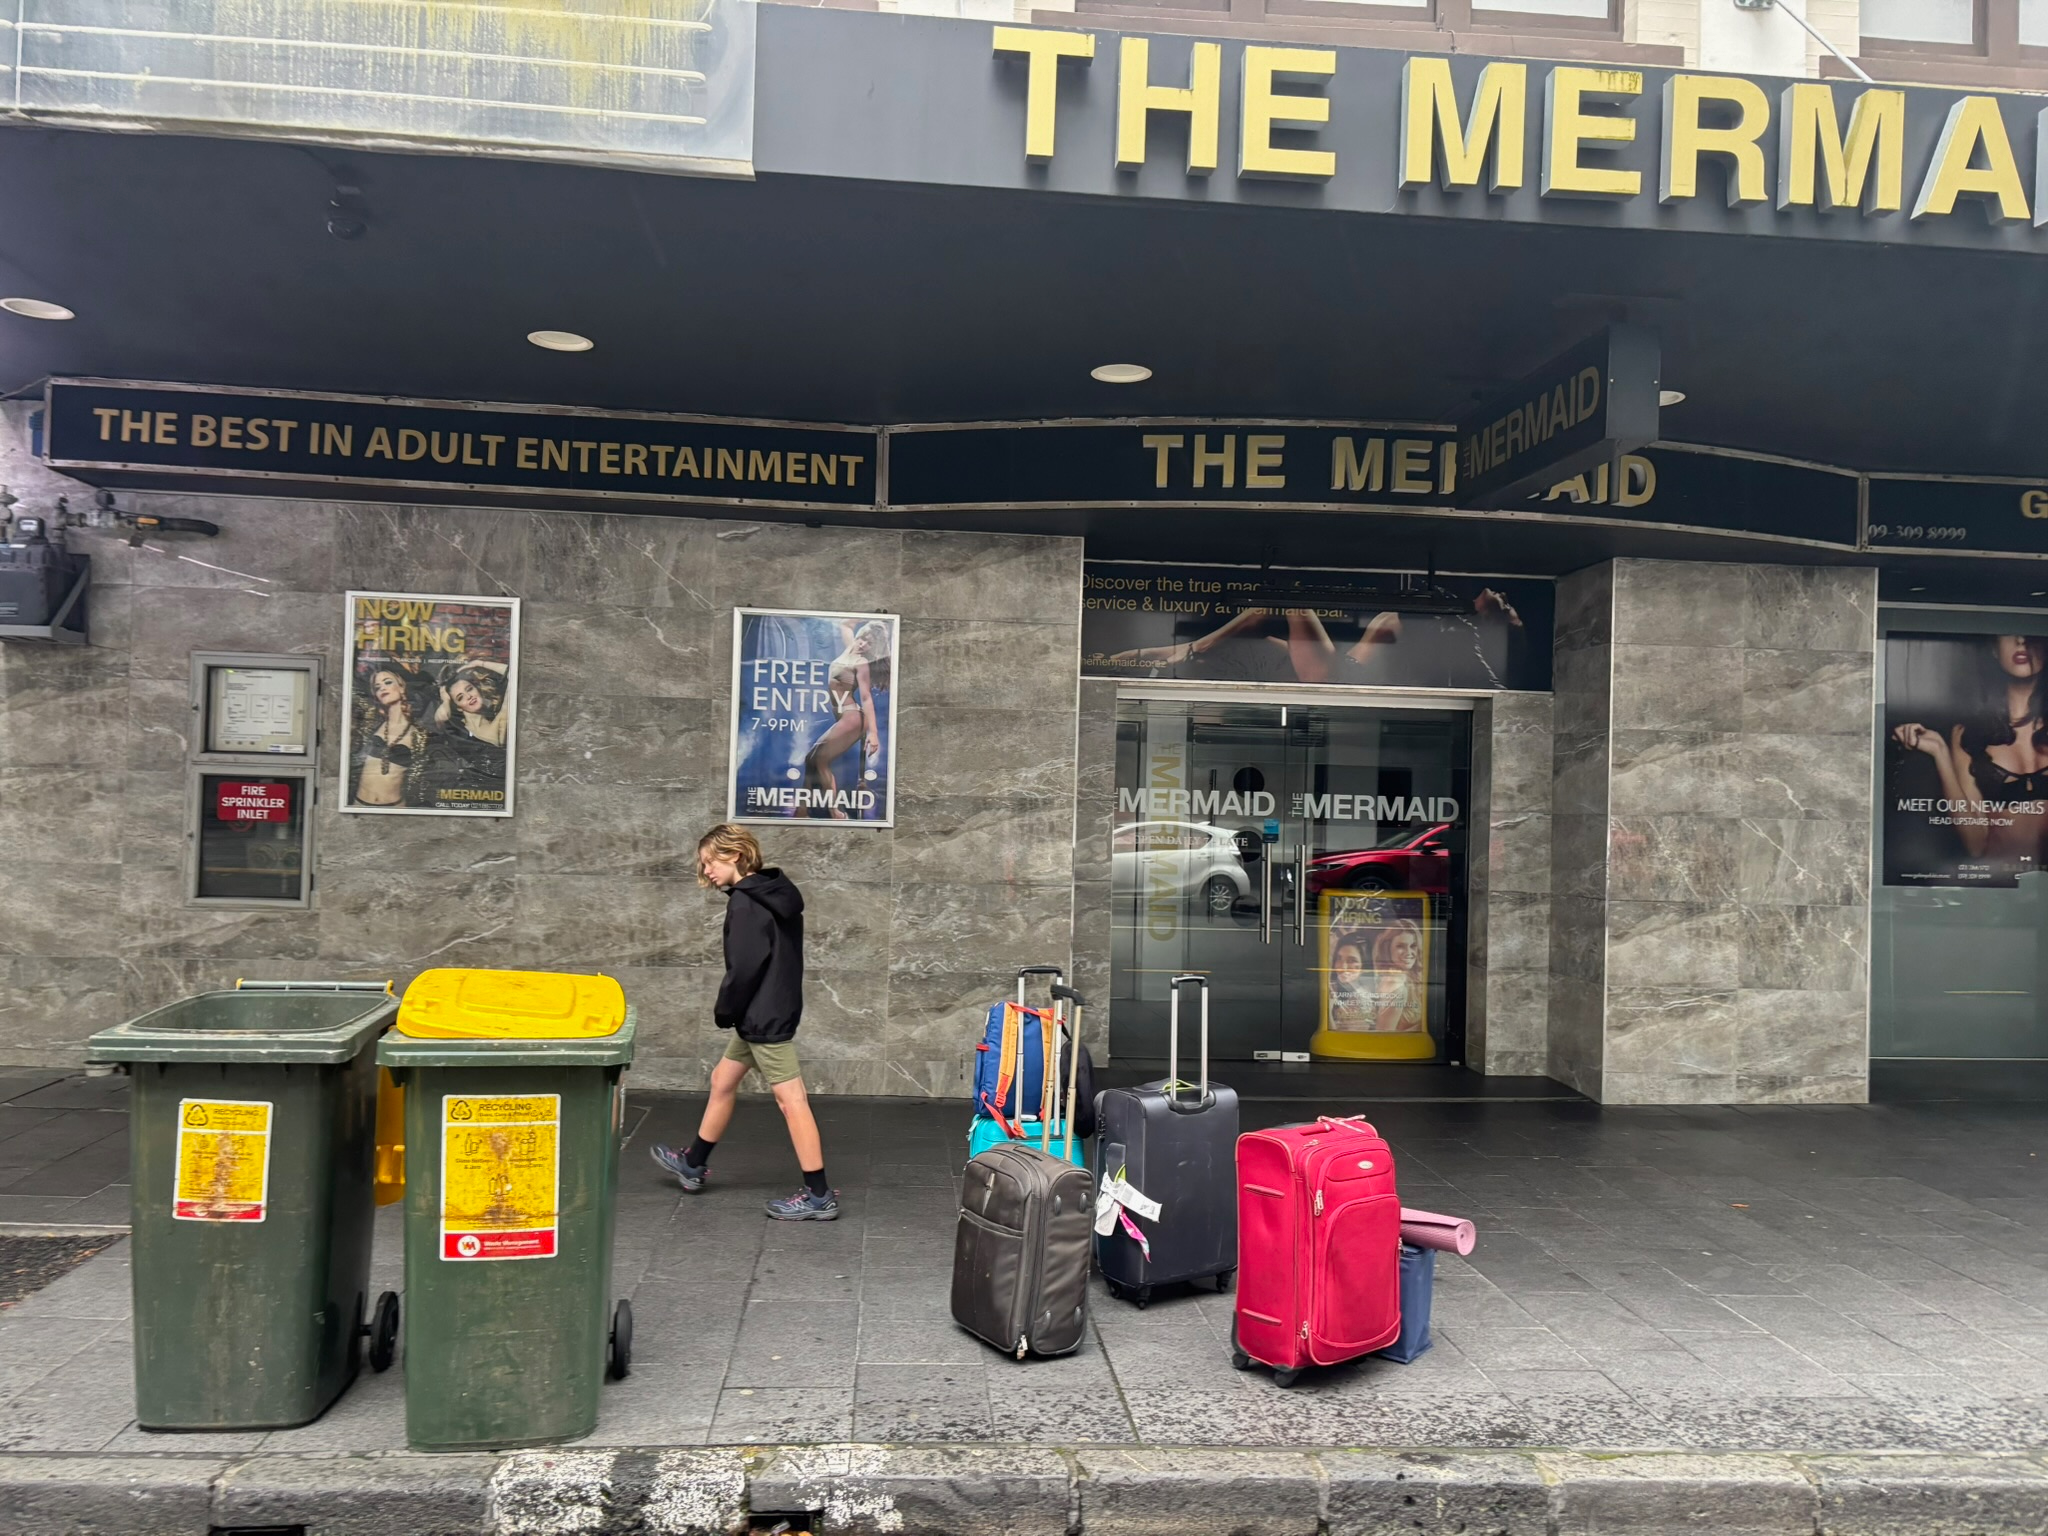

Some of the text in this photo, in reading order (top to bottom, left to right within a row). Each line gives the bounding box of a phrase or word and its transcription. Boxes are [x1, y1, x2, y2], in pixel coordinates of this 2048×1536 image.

[991, 26, 2048, 226] THE MERMA
[1469, 366, 1600, 480] MERMAID
[93, 408, 864, 488] THE BEST IN ADULT ENTERTAINMENT
[1142, 434, 1287, 491] THE
[1083, 575, 1153, 591] Discover
[1156, 577, 1184, 592] the
[1188, 578, 1222, 593] true
[357, 598, 435, 621] NOW
[1081, 595, 1137, 611] service
[1141, 595, 1155, 612] &
[1159, 597, 1212, 616] luxury
[357, 624, 466, 653] HIRING
[753, 659, 825, 686] FREE
[752, 686, 850, 714] ENTRY
[221, 796, 285, 809] SPRINKLER
[241, 785, 267, 797] FIRE
[440, 789, 504, 801] MERMAID
[747, 786, 875, 810] THE MERMAID
[1118, 787, 1276, 817] MERMAID
[236, 808, 270, 820] INLET
[1291, 792, 1460, 823] THE MERMAID
[1897, 798, 2045, 815] MEET OUR NEW GIRLS
[1928, 816, 1952, 826] HEAD
[1953, 817, 1990, 827] UPSTAIRS
[1219, 837, 1249, 847] LATE
[479, 1103, 532, 1111] RECYCLING
